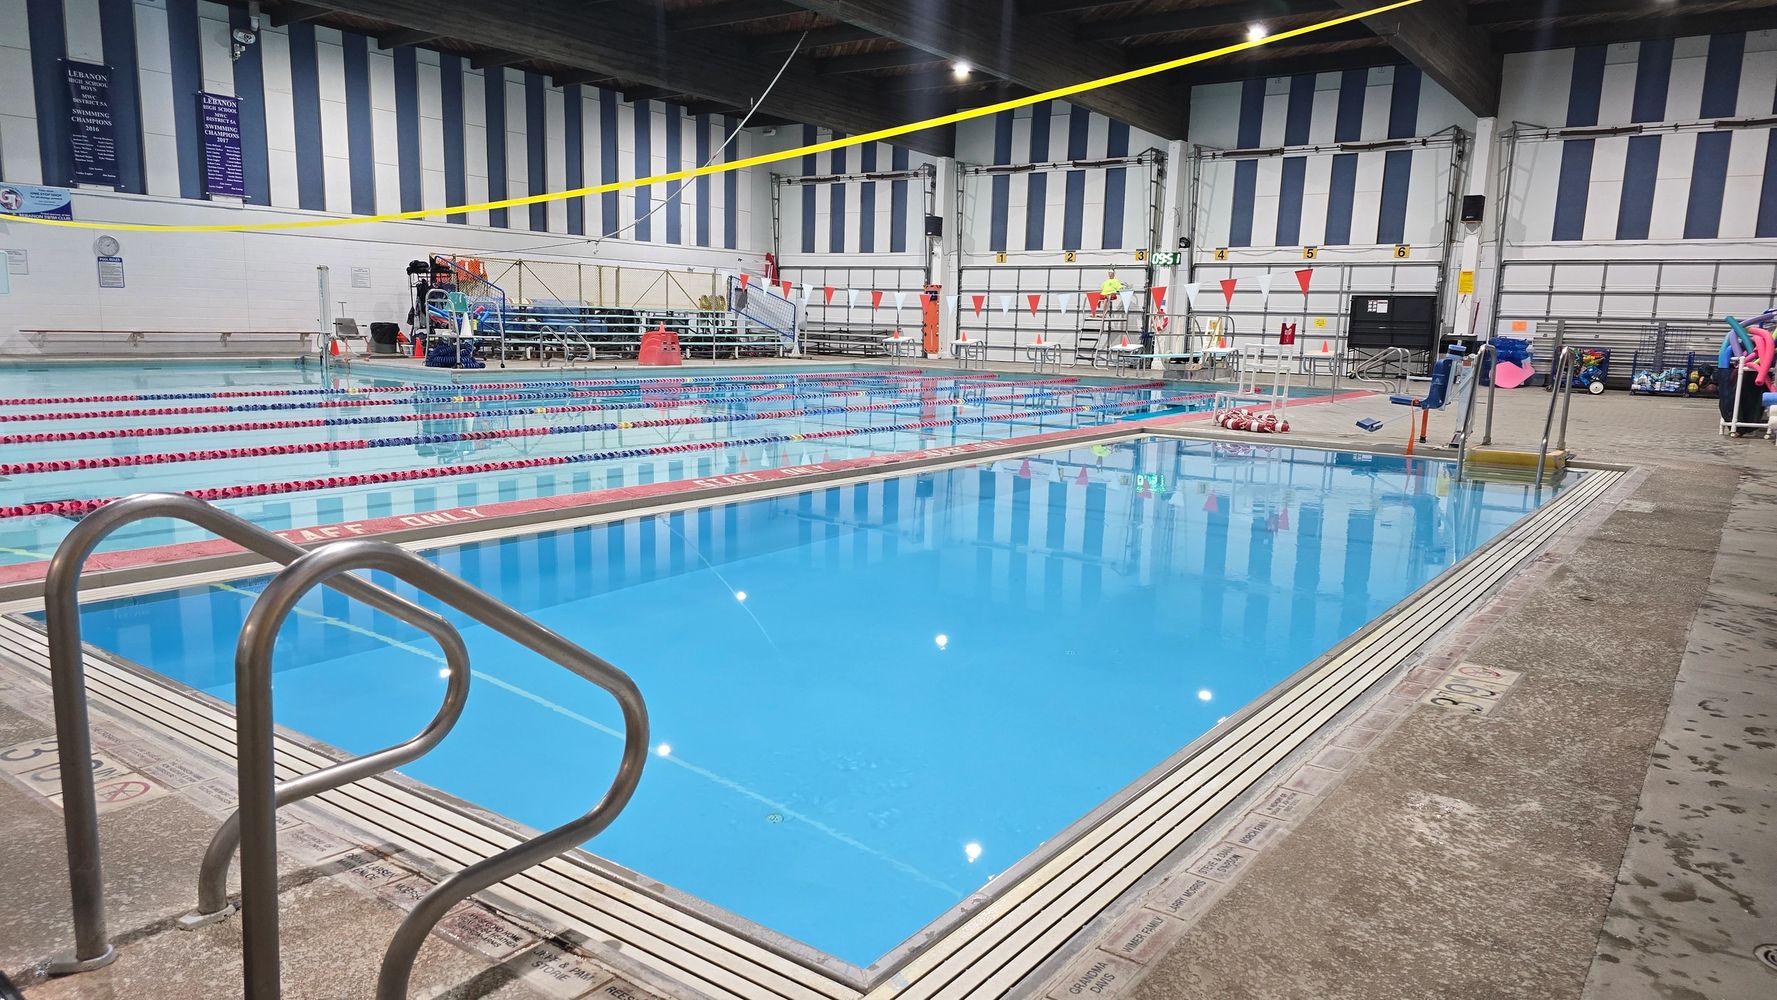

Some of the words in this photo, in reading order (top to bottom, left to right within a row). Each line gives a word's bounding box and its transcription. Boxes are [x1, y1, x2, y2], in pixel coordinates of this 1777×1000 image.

[68, 69, 107, 81] LEBANON
[85, 80, 108, 88] SCHOOL
[73, 97, 99, 106] DISTRICT
[203, 97, 237, 107] LEBANON
[72, 109, 110, 118] SWIMMING
[218, 106, 237, 114] SCHOOL
[71, 116, 113, 126] CHAMPIONS
[205, 116, 229, 124] DISTRICT
[205, 124, 238, 133] SWIMMING
[204, 130, 240, 139] CHAMPIONS
[1217, 249, 1224, 260] 4
[1306, 248, 1314, 258] 5
[1397, 246, 1406, 257] 6
[275, 523, 371, 544] TAFF
[399, 508, 486, 527] ONLY
[1142, 916, 1164, 935] FAMILY
[503, 930, 523, 943] HOME
[531, 960, 571, 982] STORIE
[569, 966, 595, 982] PAM
[1069, 961, 1109, 995] GRANDMA
[1090, 972, 1116, 995] DAVIS
